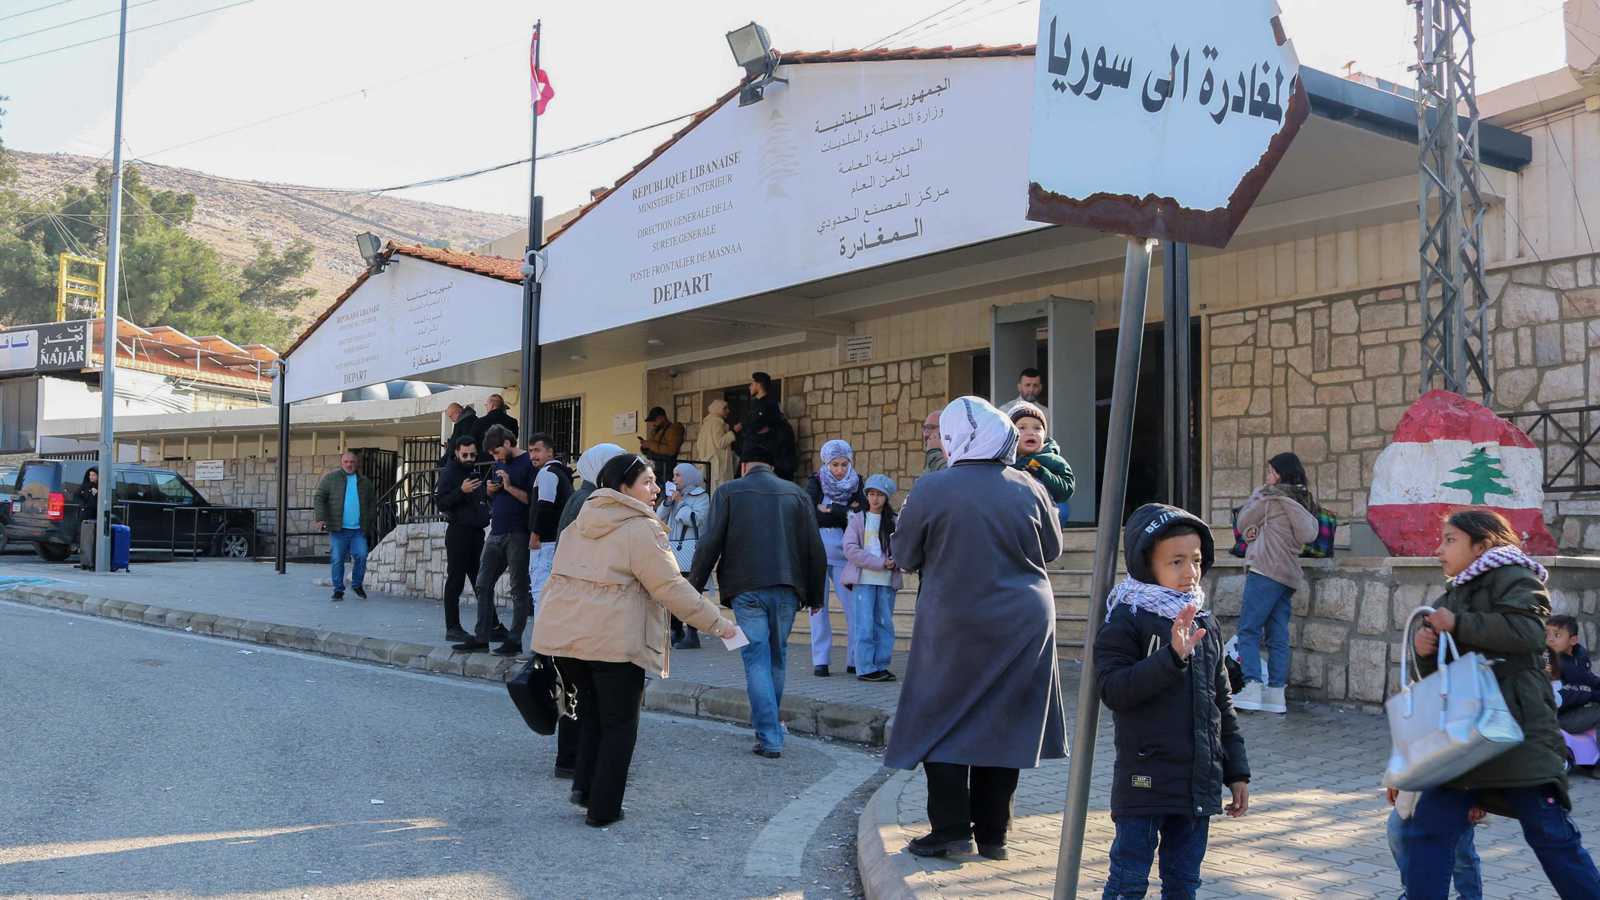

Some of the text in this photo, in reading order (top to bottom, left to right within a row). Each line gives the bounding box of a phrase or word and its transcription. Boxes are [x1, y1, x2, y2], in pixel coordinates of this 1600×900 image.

[1047, 15, 1133, 101] سوريا
[814, 77, 951, 134] الجمهورية اللبنانية
[917, 106, 944, 124] وزارة
[871, 112, 913, 135] الداخلية
[632, 151, 741, 200] REPUBLIQUE LIBANAISE
[838, 154, 872, 174] العامة
[638, 175, 733, 214] MINISTERE DE L'INTERIEUR
[850, 176, 875, 197] العام
[915, 186, 949, 207] مركز
[637, 199, 733, 239] DIRECTION GENERALE DE LA
[863, 192, 911, 223] المصنع
[652, 224, 717, 252] SURETE GENERALE
[839, 216, 923, 259] المغادرة
[630, 240, 743, 282] POSTE FRONTALIER DE MASNAA
[653, 272, 713, 304] DEPART
[40, 350, 85, 366] NAJJAR
[343, 369, 368, 384] DEPART
